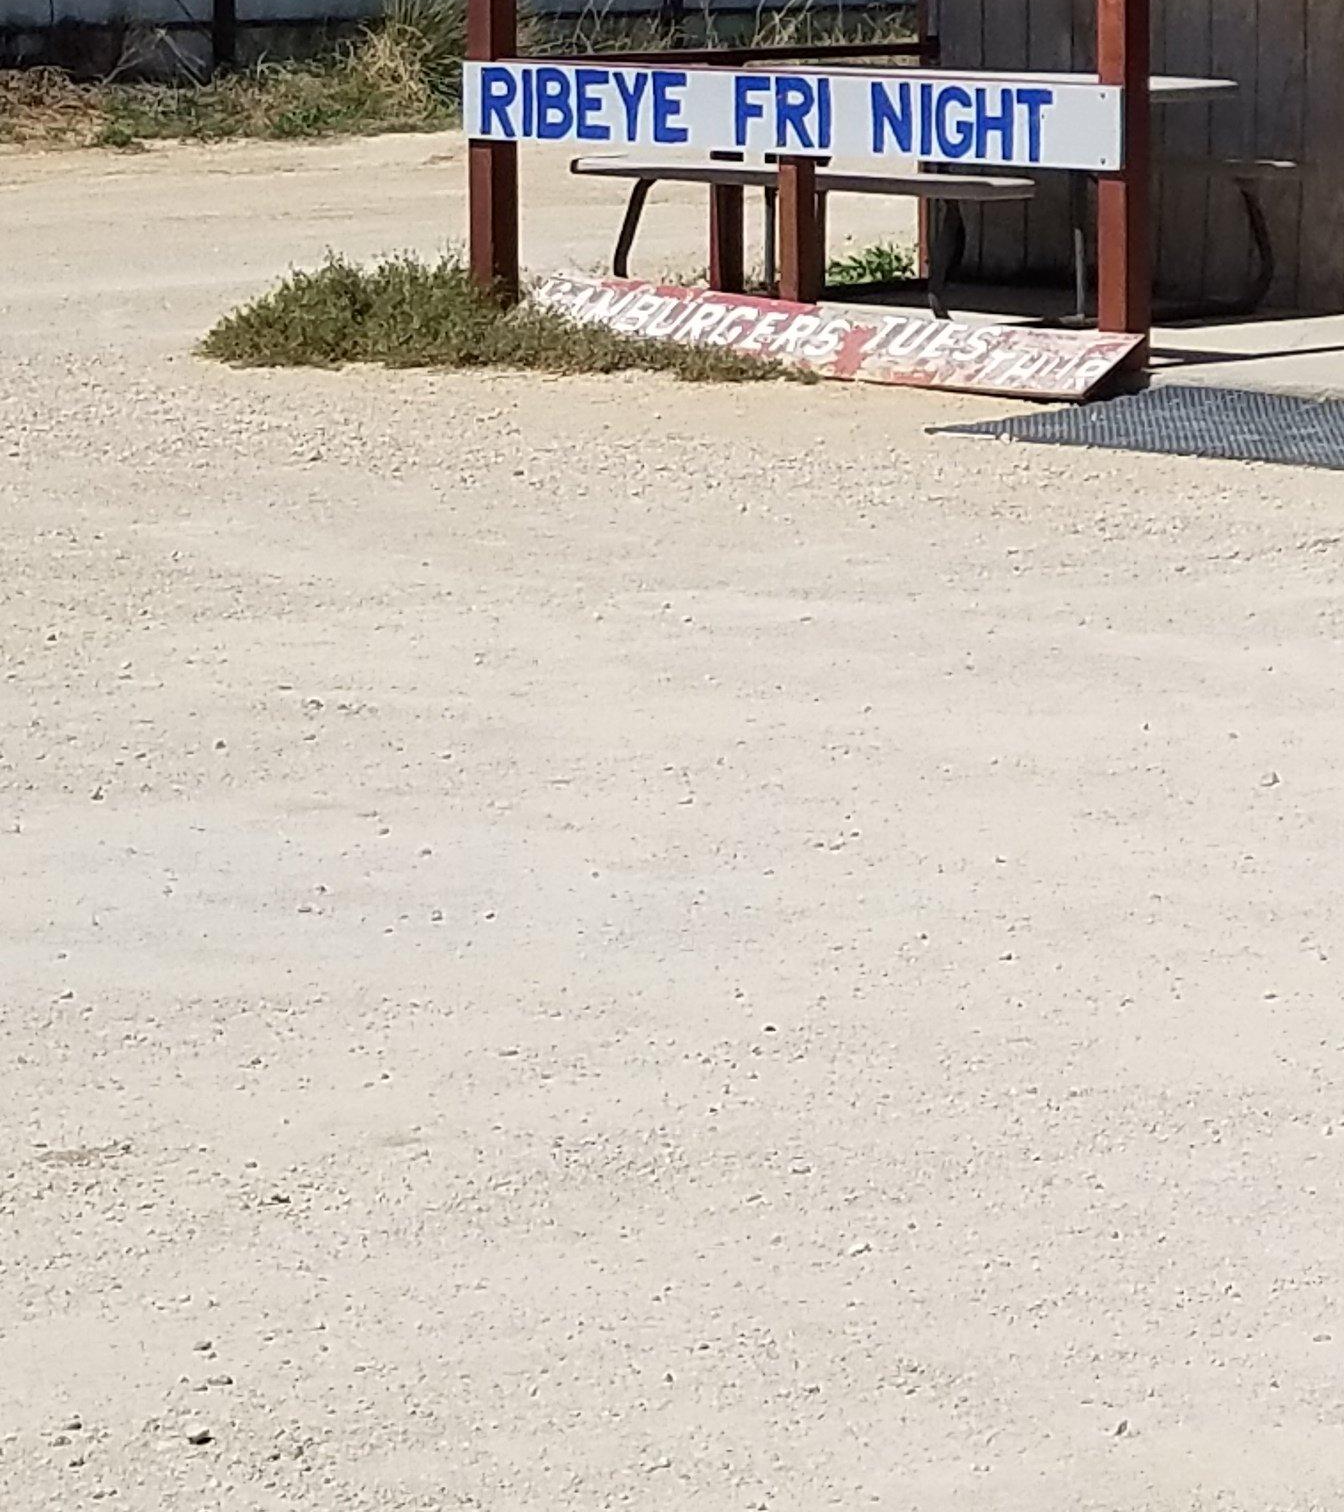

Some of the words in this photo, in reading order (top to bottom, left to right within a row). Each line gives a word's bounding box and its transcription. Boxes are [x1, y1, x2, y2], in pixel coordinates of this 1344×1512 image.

[480, 67, 689, 143] RIBEYE
[734, 75, 831, 148] FRI
[871, 81, 1054, 163] NIGHT
[861, 316, 1003, 361] TUES
